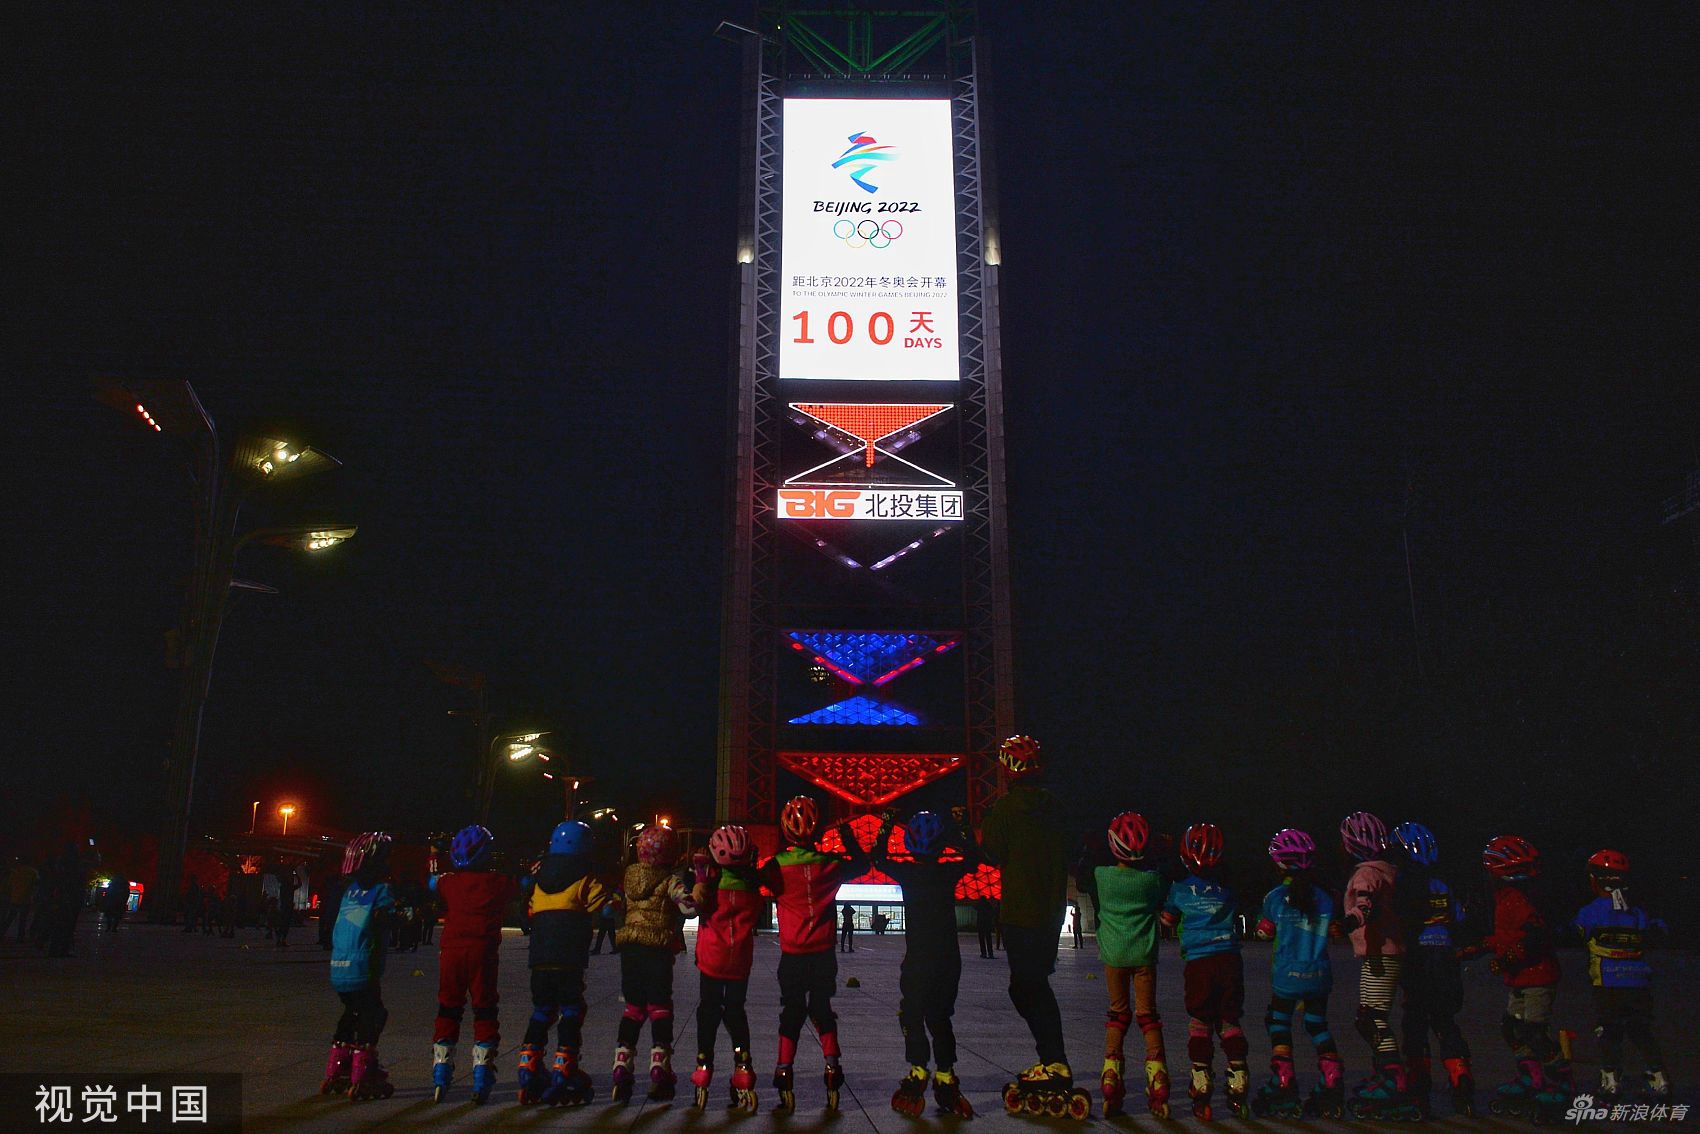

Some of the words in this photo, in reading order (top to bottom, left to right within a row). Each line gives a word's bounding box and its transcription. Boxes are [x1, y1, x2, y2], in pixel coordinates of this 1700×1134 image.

[813, 201, 872, 216] BEIJING
[878, 201, 922, 213] 2022
[792, 275, 948, 289] 距北京2022年冬奥会开幕
[817, 290, 849, 298] OLYMPIC
[793, 310, 895, 345] 100
[909, 311, 934, 333] 天
[904, 337, 943, 349] DAYS
[779, 491, 861, 517] BIG
[865, 493, 962, 518] 北投集团
